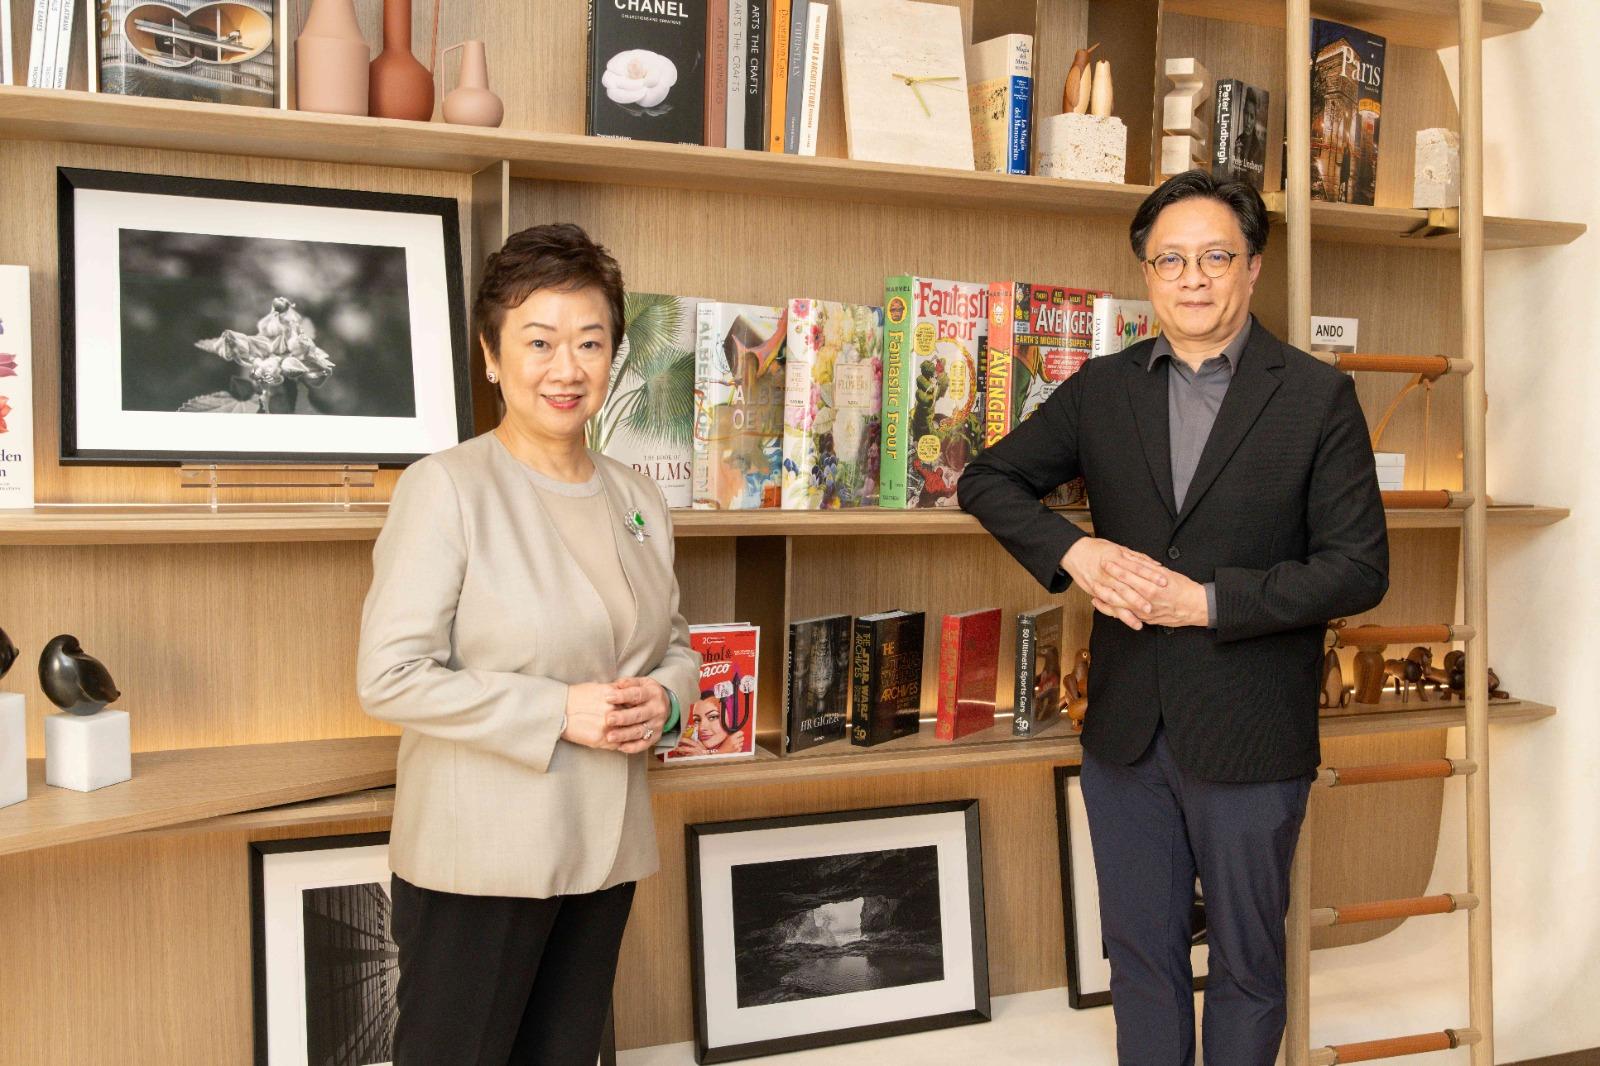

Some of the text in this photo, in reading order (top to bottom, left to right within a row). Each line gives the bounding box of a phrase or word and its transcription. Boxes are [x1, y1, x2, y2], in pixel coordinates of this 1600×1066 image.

[614, 0, 688, 18] CHANEL
[731, 2, 742, 93] ARTS THE CRAFTS
[749, 4, 760, 95] ARTS THE CRAFTS
[1339, 45, 1381, 87] Paris
[807, 61, 818, 108] ARCHITECTURE
[1218, 84, 1231, 164] Peter Lindbergh
[1013, 119, 1021, 161] Manoscritto
[1019, 128, 1027, 151] Magia
[1116, 313, 1148, 337] David
[1315, 324, 1344, 338] ANDO
[1015, 335, 1039, 345] EARTH'S
[886, 330, 904, 460] Fantastic Four
[987, 348, 1011, 448] AVENGERS
[631, 462, 691, 481] PALMS
[862, 633, 871, 647] THE
[1022, 628, 1030, 639] 50
[854, 631, 863, 679] ARCHIVES
[1021, 639, 1029, 670] Ultimate
[1020, 671, 1028, 696] Sports
[1019, 696, 1027, 713] Cars
